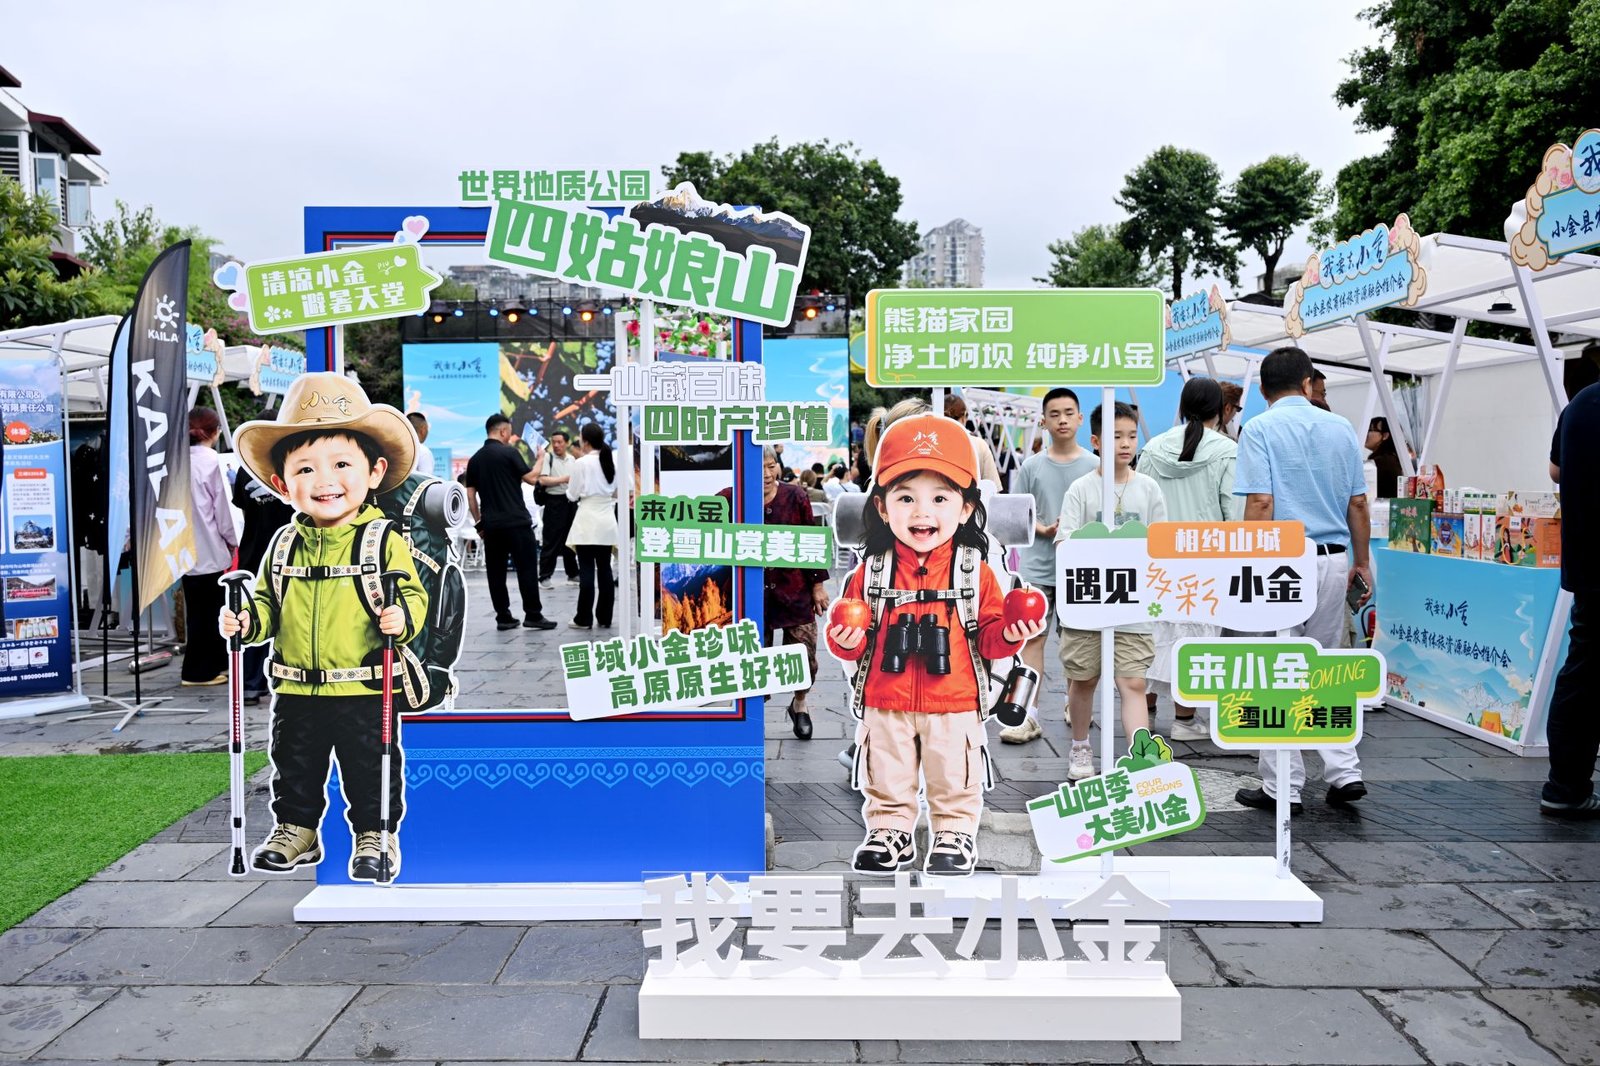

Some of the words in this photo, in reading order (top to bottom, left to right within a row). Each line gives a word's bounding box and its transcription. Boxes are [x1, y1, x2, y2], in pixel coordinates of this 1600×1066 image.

[458, 170, 650, 201] 世界地质公园
[488, 198, 795, 322] 四姑娘山
[261, 261, 367, 297] 清凉小金
[301, 281, 407, 318] 避暑天堂
[148, 329, 179, 343] KAILA
[884, 306, 1013, 333] 熊猫家园
[884, 343, 1013, 369] 净土阿坝
[1026, 342, 1154, 369] 纯净小金
[577, 365, 762, 402] 一山藏百味
[641, 499, 724, 523] 来小金
[641, 527, 827, 564] 登雪山赏美景
[1175, 527, 1281, 552] 相约山城
[561, 621, 761, 679] 雪域小金珍味
[608, 651, 805, 709] 高原原生好物
[1188, 652, 1310, 690] 来小金
[1299, 658, 1367, 692] COMING
[1029, 769, 1133, 818] 一山四季
[1136, 777, 1162, 790] FOUR
[1137, 779, 1184, 798] SEASONS
[1084, 793, 1191, 846] 大美小金
[641, 871, 1172, 979] 我要去小金
